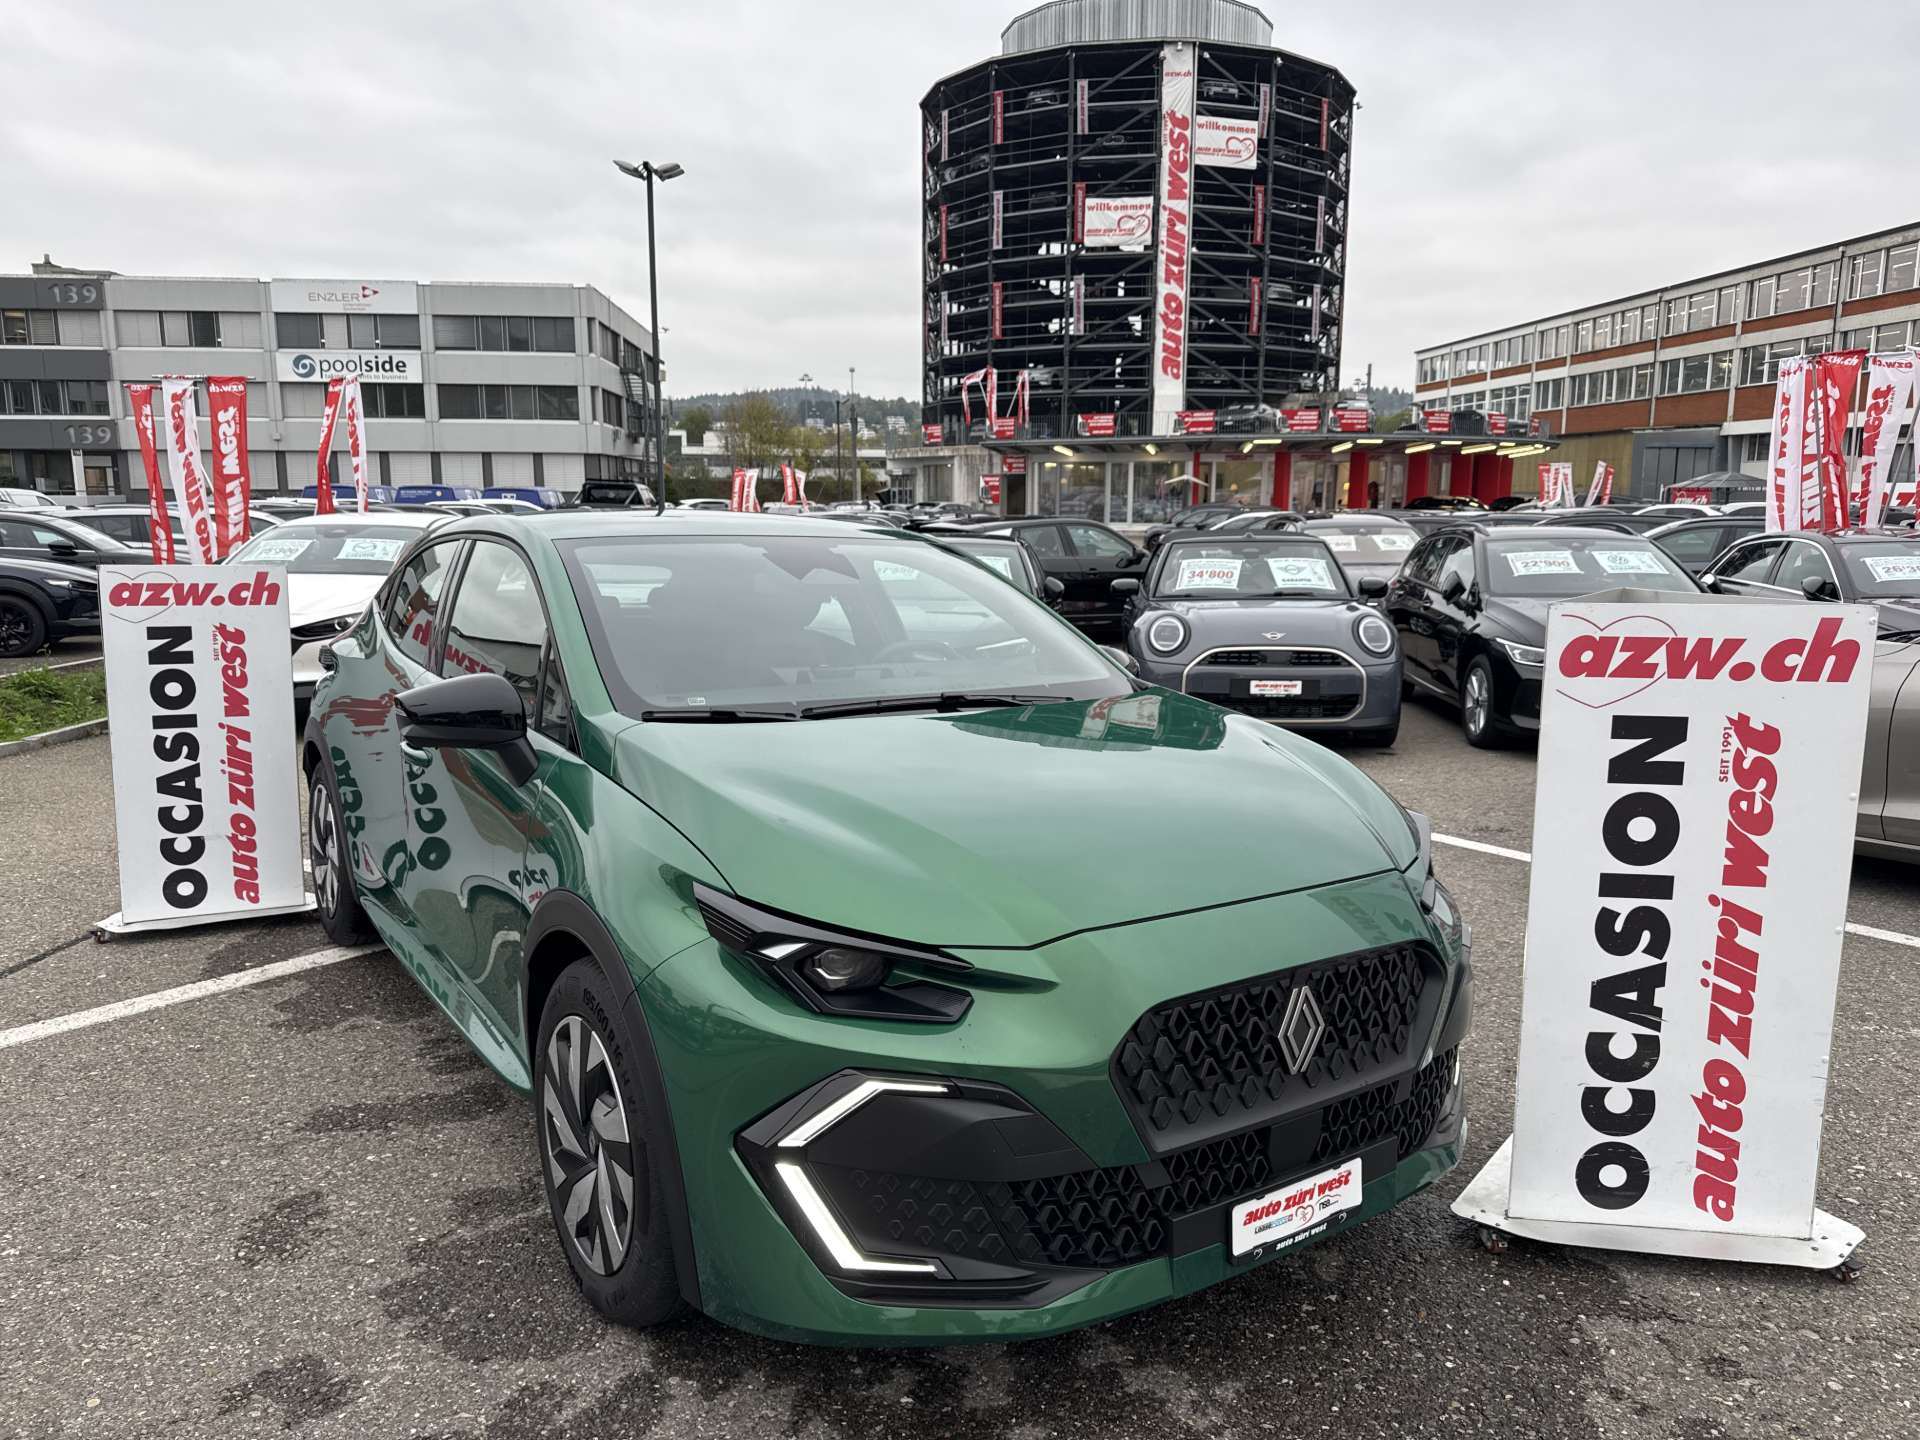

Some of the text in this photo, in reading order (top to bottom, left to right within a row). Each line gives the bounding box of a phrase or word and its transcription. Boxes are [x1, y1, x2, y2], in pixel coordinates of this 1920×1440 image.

[1196, 120, 1257, 134] willkommen
[1087, 202, 1151, 212] willkommen
[1159, 109, 1191, 380] auto züri west
[50, 283, 97, 304] 139
[308, 291, 361, 302] ENZLER
[319, 354, 407, 379] poolside
[63, 425, 112, 444] 139
[108, 572, 281, 607] azw.ch
[1187, 569, 1234, 580] 34'800
[1557, 617, 1861, 683] azw.ch
[146, 625, 208, 910] OCCASION
[213, 622, 261, 904] auto züri west
[1719, 724, 1734, 784] SEIT 1991
[1575, 714, 1690, 1210] OCCASION
[1689, 711, 1783, 1222] auto züri west
[1243, 1200, 1282, 1226] auto
[1282, 1182, 1317, 1212] züri
[1317, 1169, 1352, 1197] west
[1276, 1237, 1294, 1251] auto
[1294, 1230, 1311, 1244] züri
[1310, 1223, 1328, 1236] west
